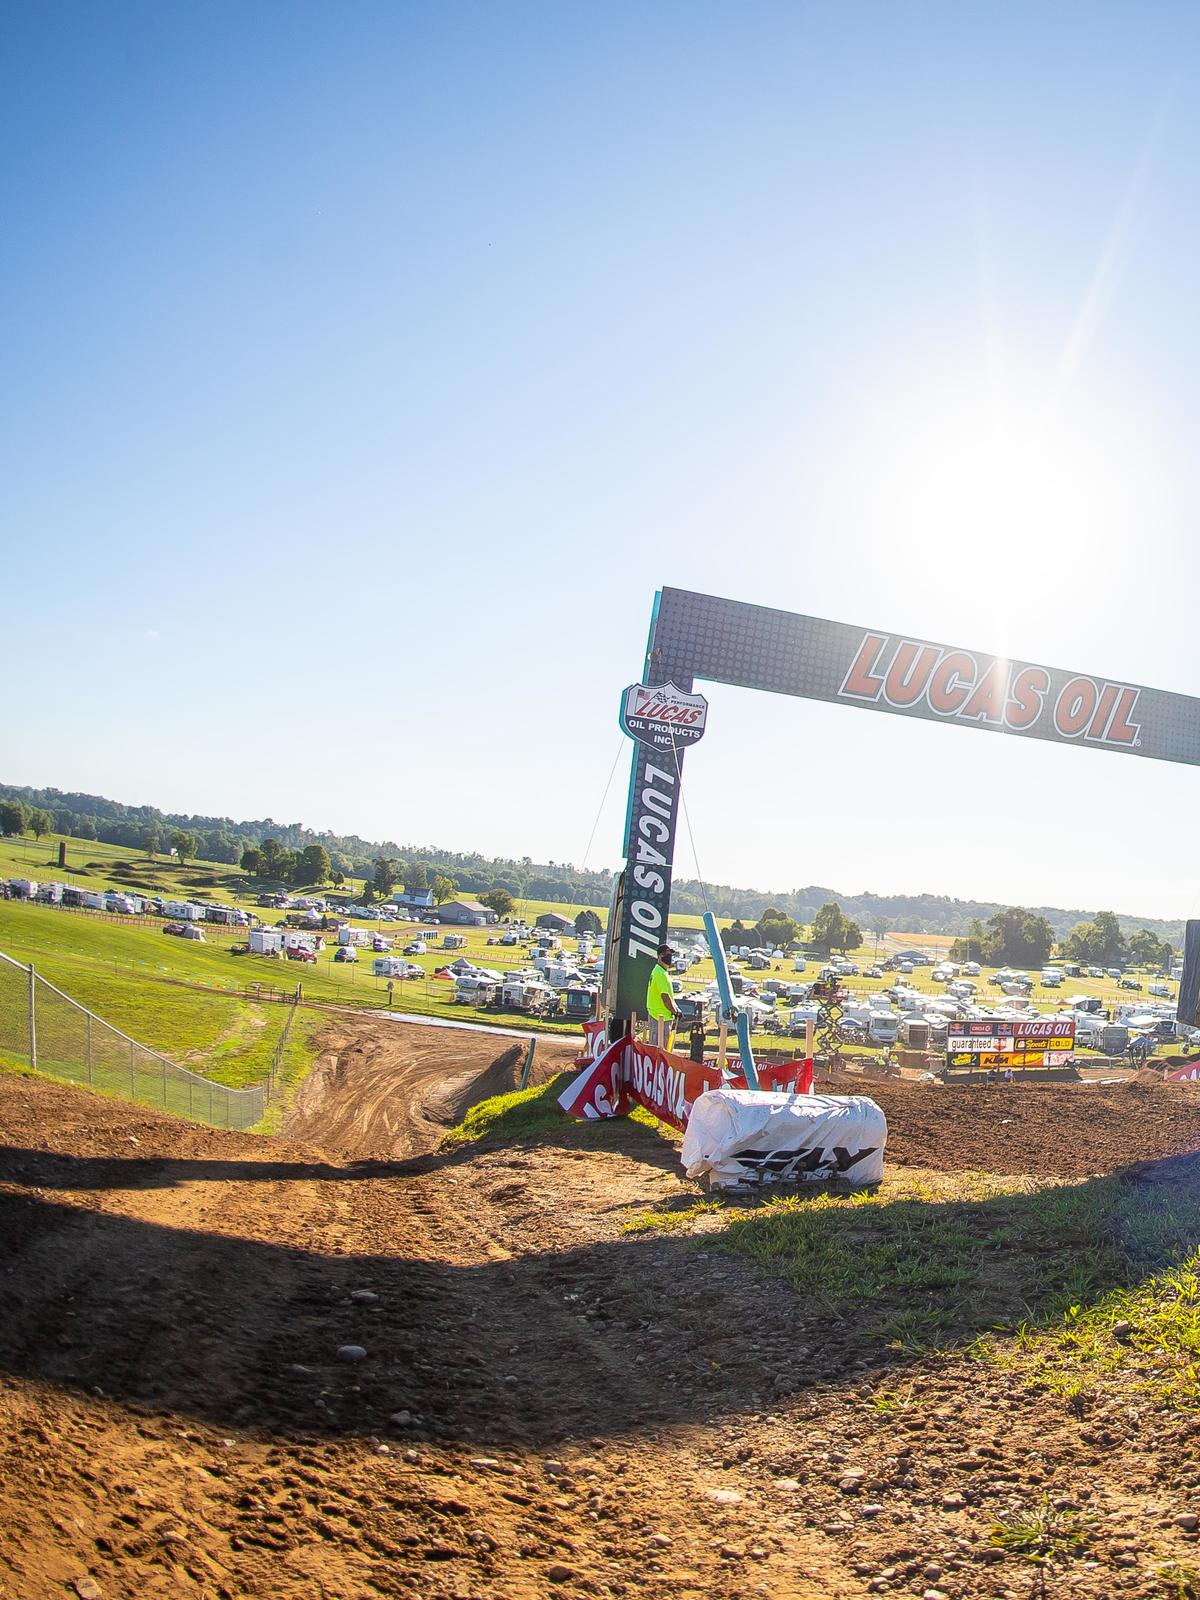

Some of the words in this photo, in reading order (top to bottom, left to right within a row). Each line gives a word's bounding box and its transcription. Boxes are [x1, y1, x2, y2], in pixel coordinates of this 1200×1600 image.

[838, 632, 1050, 730] LUCAS
[1053, 676, 1141, 746] OIL
[634, 701, 702, 724] LUCAS
[628, 720, 645, 729] OIL
[648, 723, 700, 738] PRODUCTS
[634, 763, 675, 894] LUCAS
[628, 900, 662, 959] OIL
[1018, 1023, 1053, 1035] LUCAS
[1054, 1023, 1070, 1035] OIL
[952, 1038, 991, 1051] guaranteed
